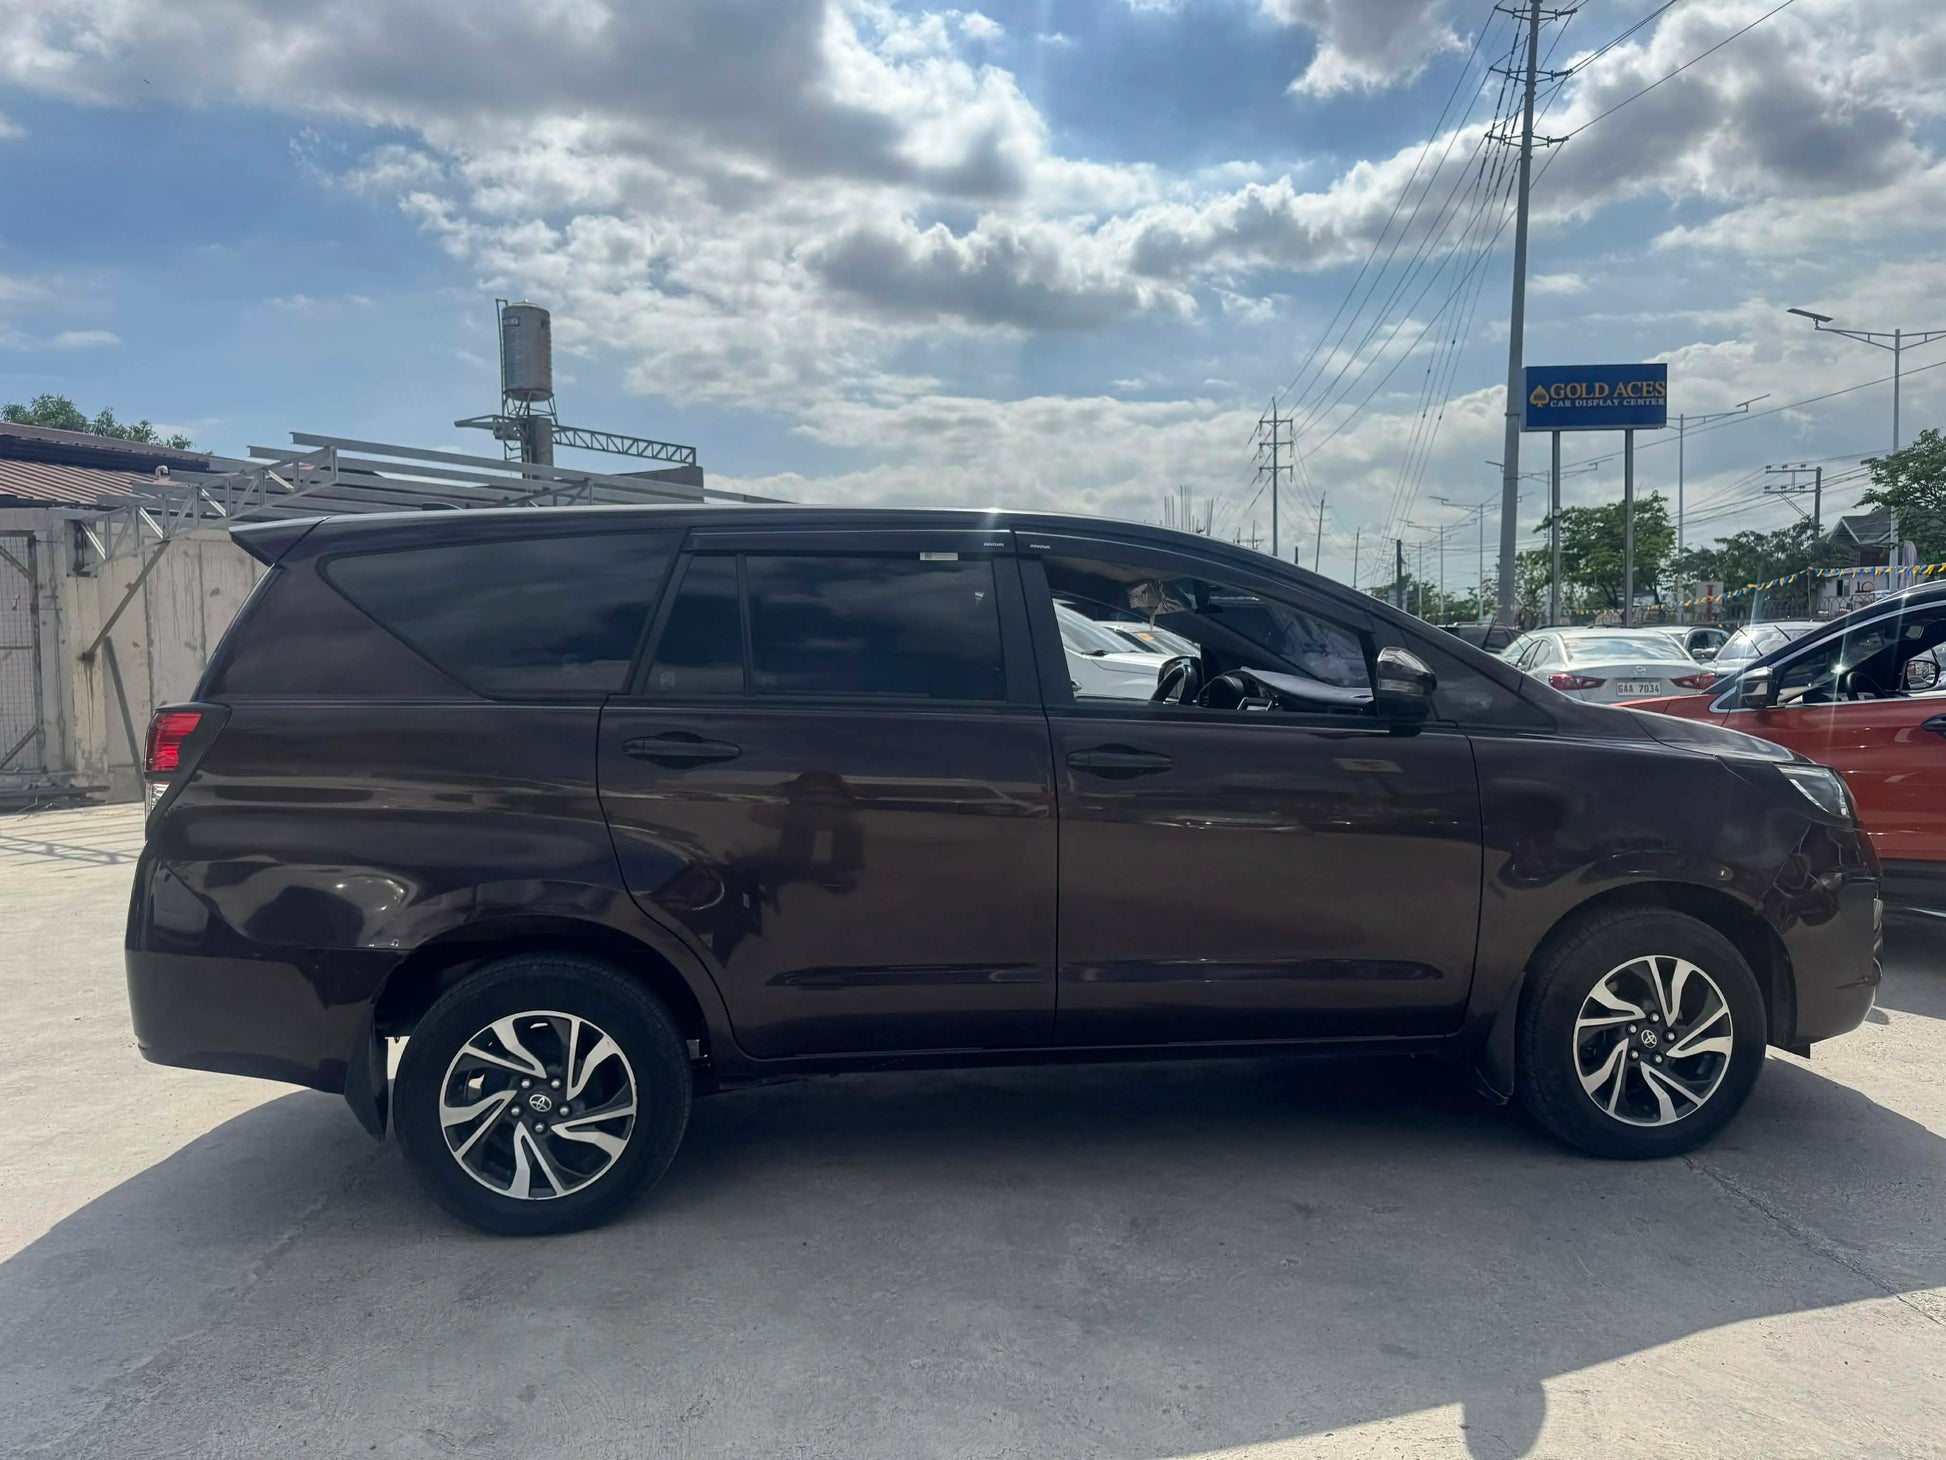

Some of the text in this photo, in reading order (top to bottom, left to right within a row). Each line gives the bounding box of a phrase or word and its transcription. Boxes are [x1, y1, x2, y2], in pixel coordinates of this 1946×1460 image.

[1549, 381, 1666, 399] GOLD ACES
[1550, 398, 1666, 408] CAR DISPLAY CENTER
[1618, 684, 1660, 694] GAA 7034
